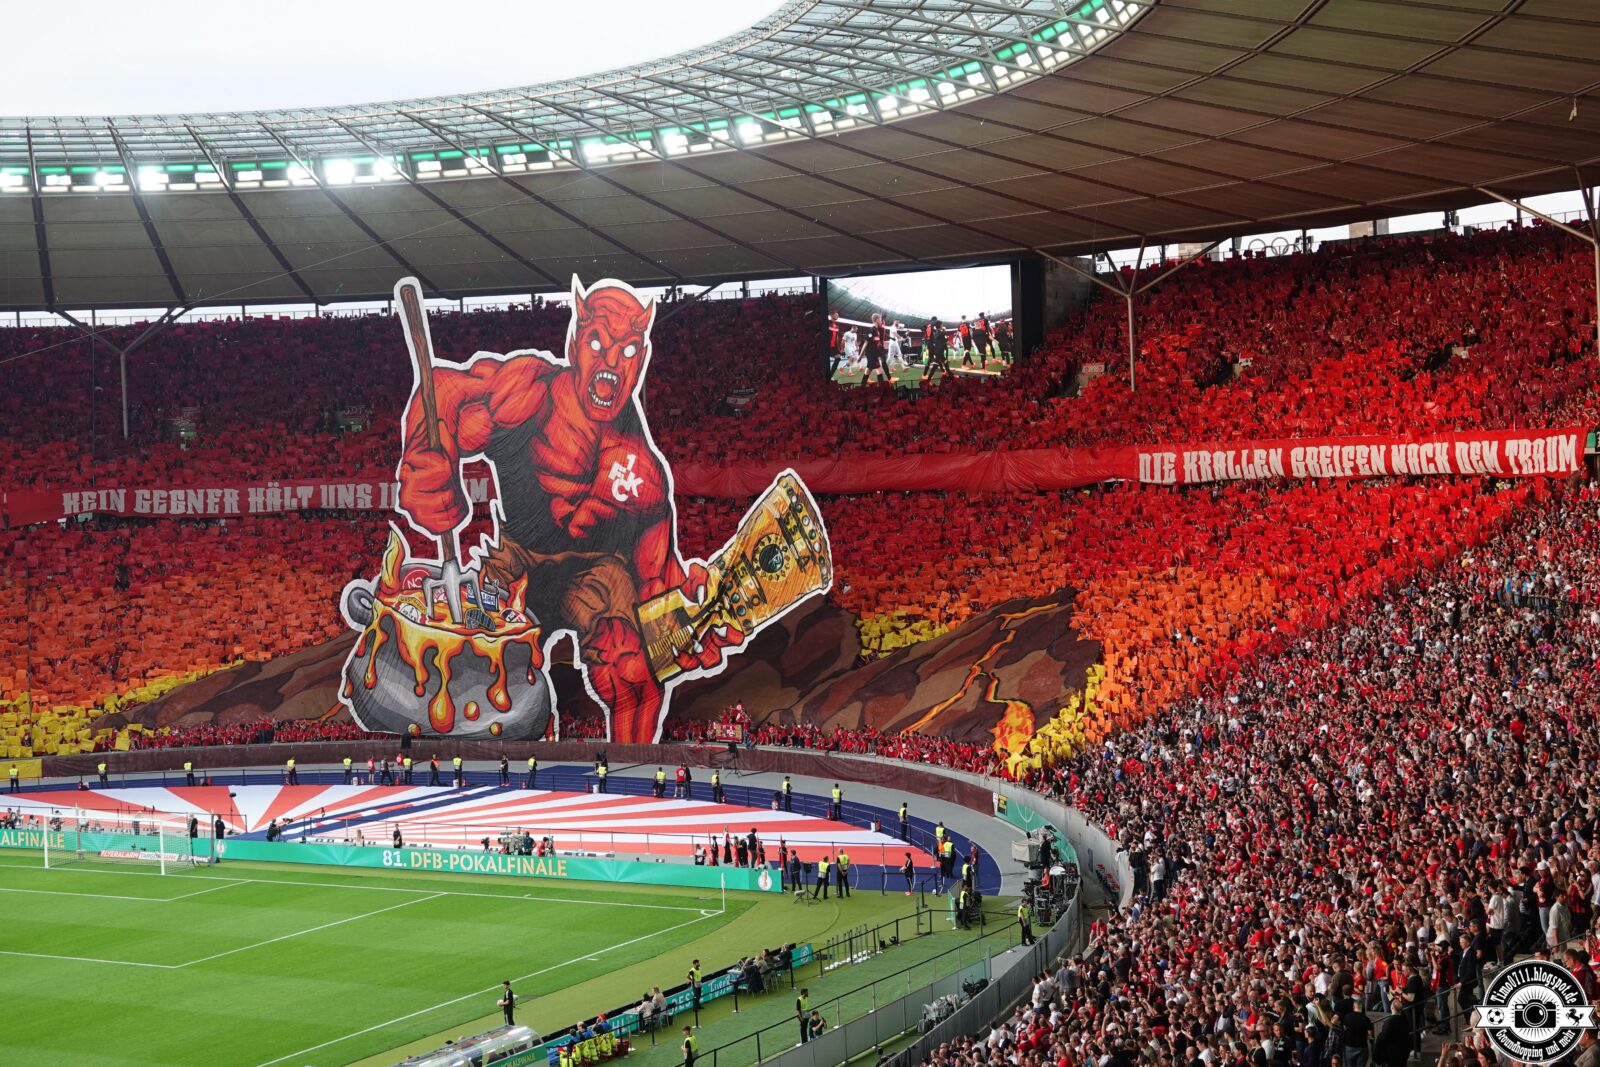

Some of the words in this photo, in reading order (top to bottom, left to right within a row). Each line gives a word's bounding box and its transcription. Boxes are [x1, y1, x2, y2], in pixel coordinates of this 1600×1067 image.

[1139, 453, 1177, 484] DIE
[1183, 448, 1286, 483] KRALLEN
[1291, 444, 1387, 477] GREIFEN
[1391, 442, 1451, 474] NACH
[1455, 440, 1504, 474] DEM
[1505, 434, 1579, 474] TRAUM
[62, 489, 127, 514] KEIN
[134, 489, 240, 514] GEGNER
[248, 481, 314, 513] HÄLT
[320, 484, 373, 509] UNS
[382, 850, 407, 867] 81.
[410, 851, 568, 877] DFB-POKALFINALE
